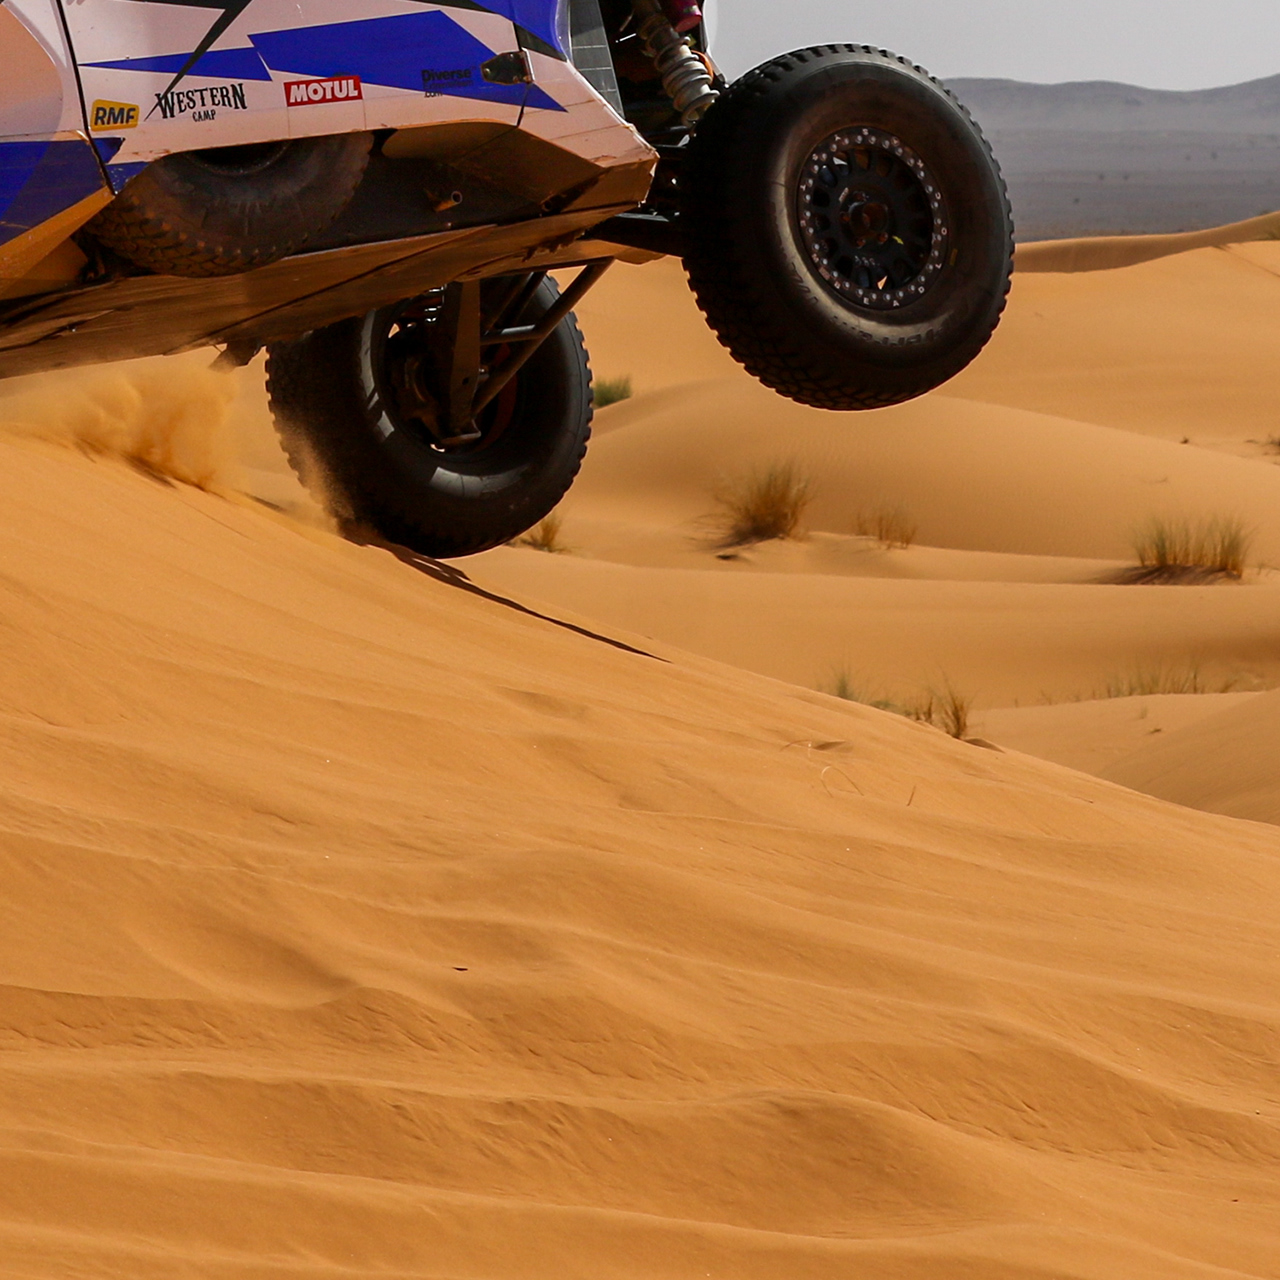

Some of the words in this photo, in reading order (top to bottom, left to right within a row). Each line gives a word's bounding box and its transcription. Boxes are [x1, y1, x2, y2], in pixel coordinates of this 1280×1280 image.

[422, 68, 472, 82] Diverse
[155, 83, 248, 120] WESTERN
[289, 79, 360, 104] MOTUL
[94, 106, 137, 126] RMF
[192, 109, 217, 122] CAMP
